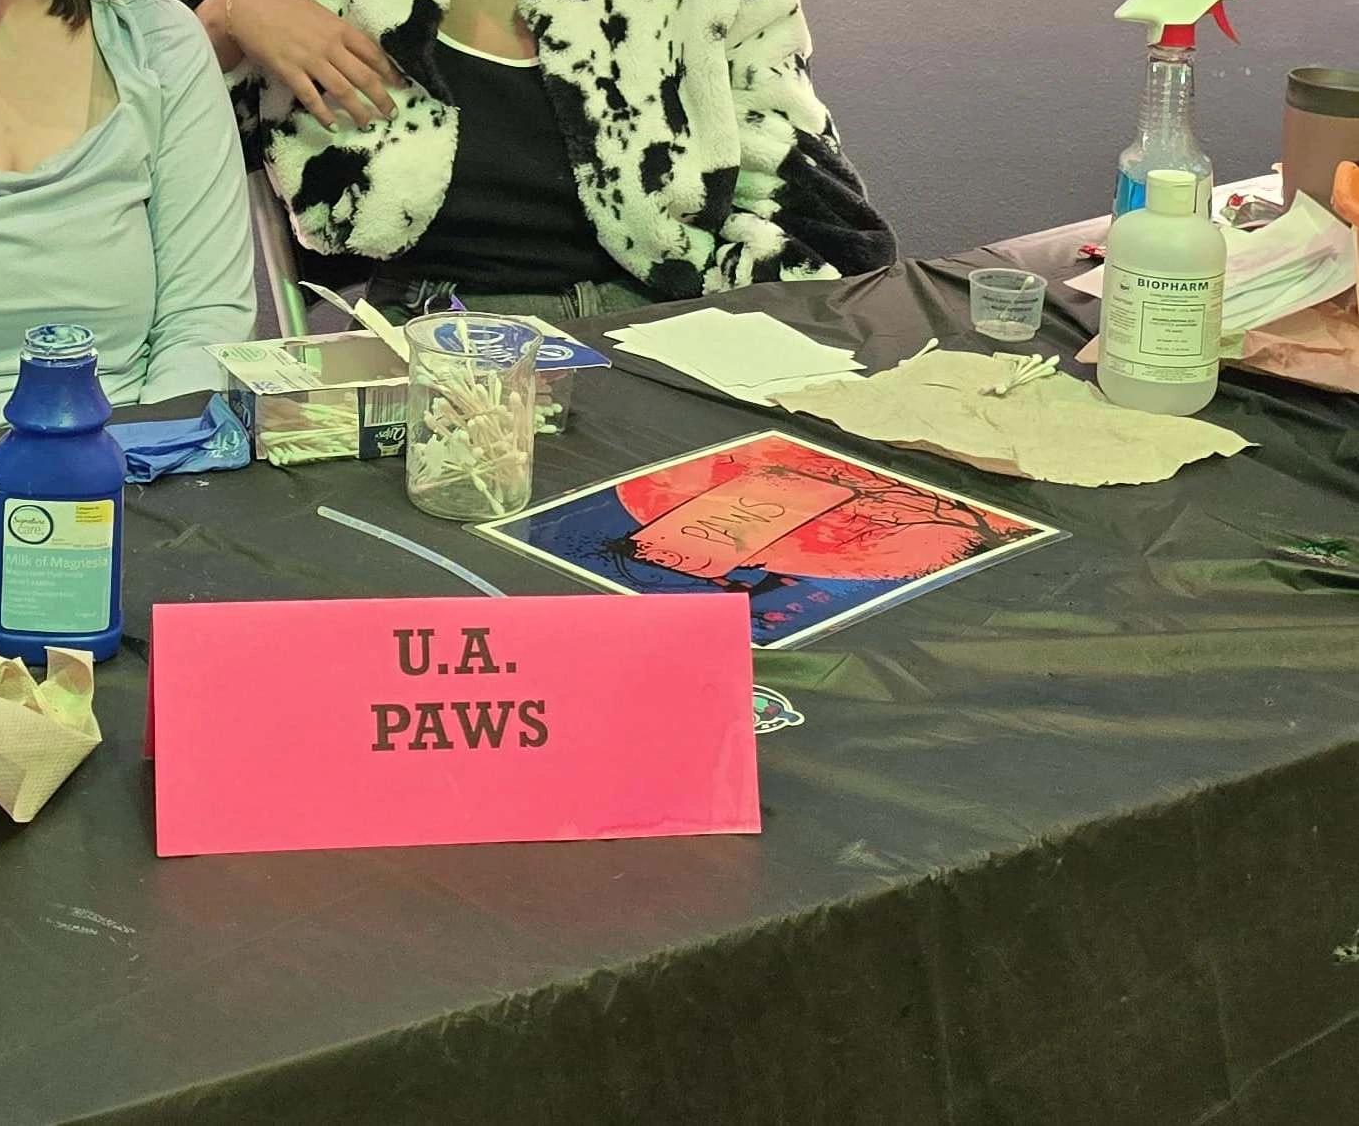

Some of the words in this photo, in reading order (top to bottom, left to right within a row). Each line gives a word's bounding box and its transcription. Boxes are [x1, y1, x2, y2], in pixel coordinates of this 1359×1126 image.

[1137, 278, 1209, 292] BIOPHARM
[681, 497, 785, 547] PAWS
[392, 627, 517, 676] U.A.
[370, 700, 548, 752] PAWS
